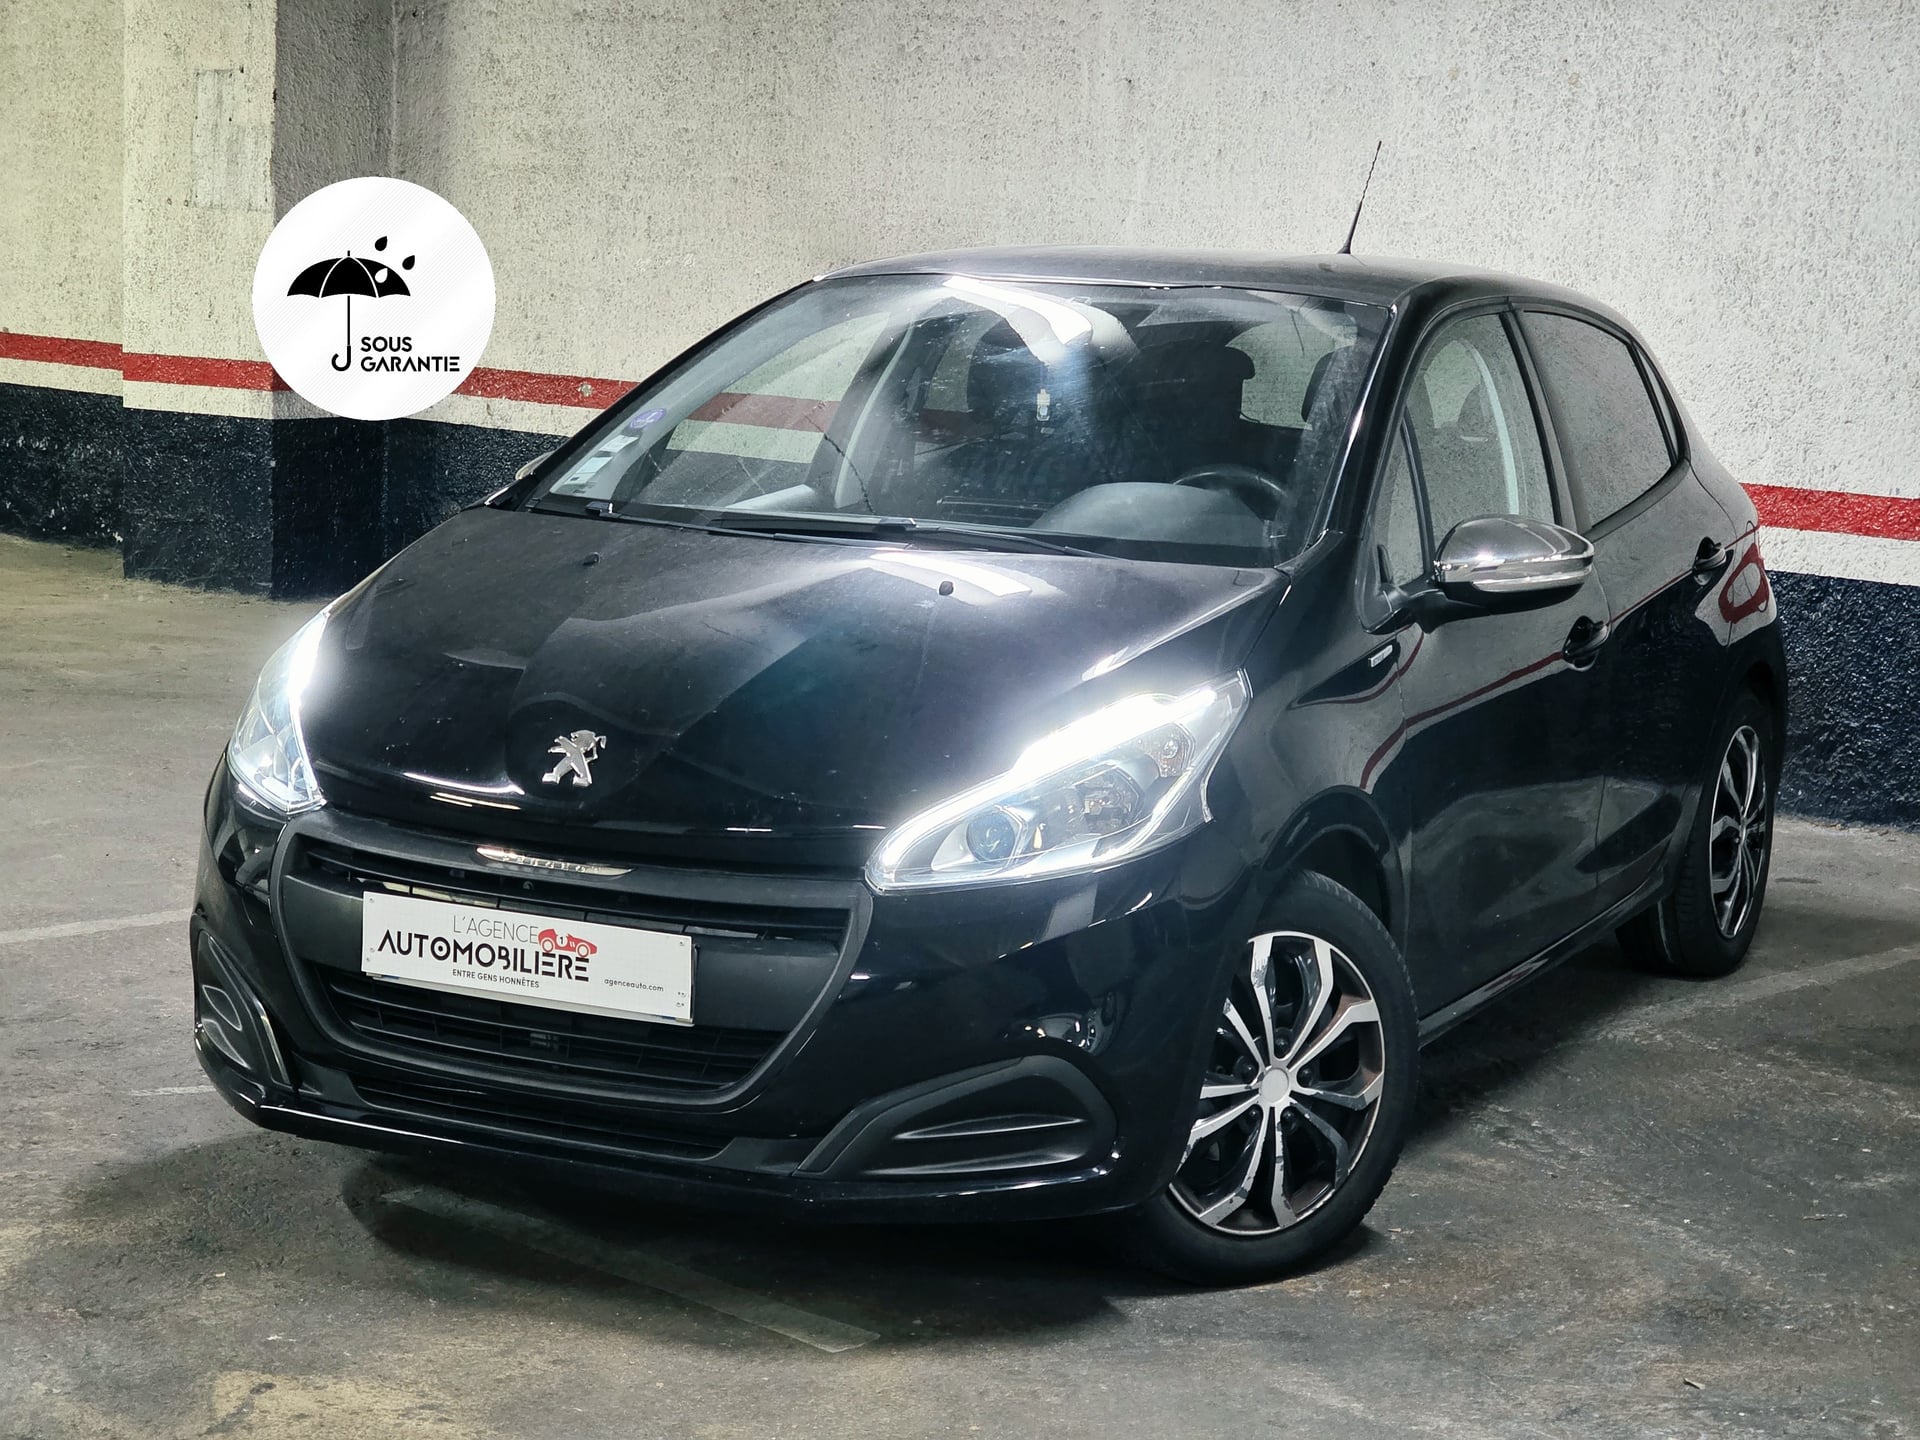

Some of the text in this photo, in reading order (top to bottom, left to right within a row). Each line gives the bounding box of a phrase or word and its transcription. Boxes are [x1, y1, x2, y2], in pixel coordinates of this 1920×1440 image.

[453, 915, 539, 945] L'AGENCE
[452, 968, 540, 989] ENTRE GENS HONNÊTES
[603, 978, 664, 992] agenceauto.com
